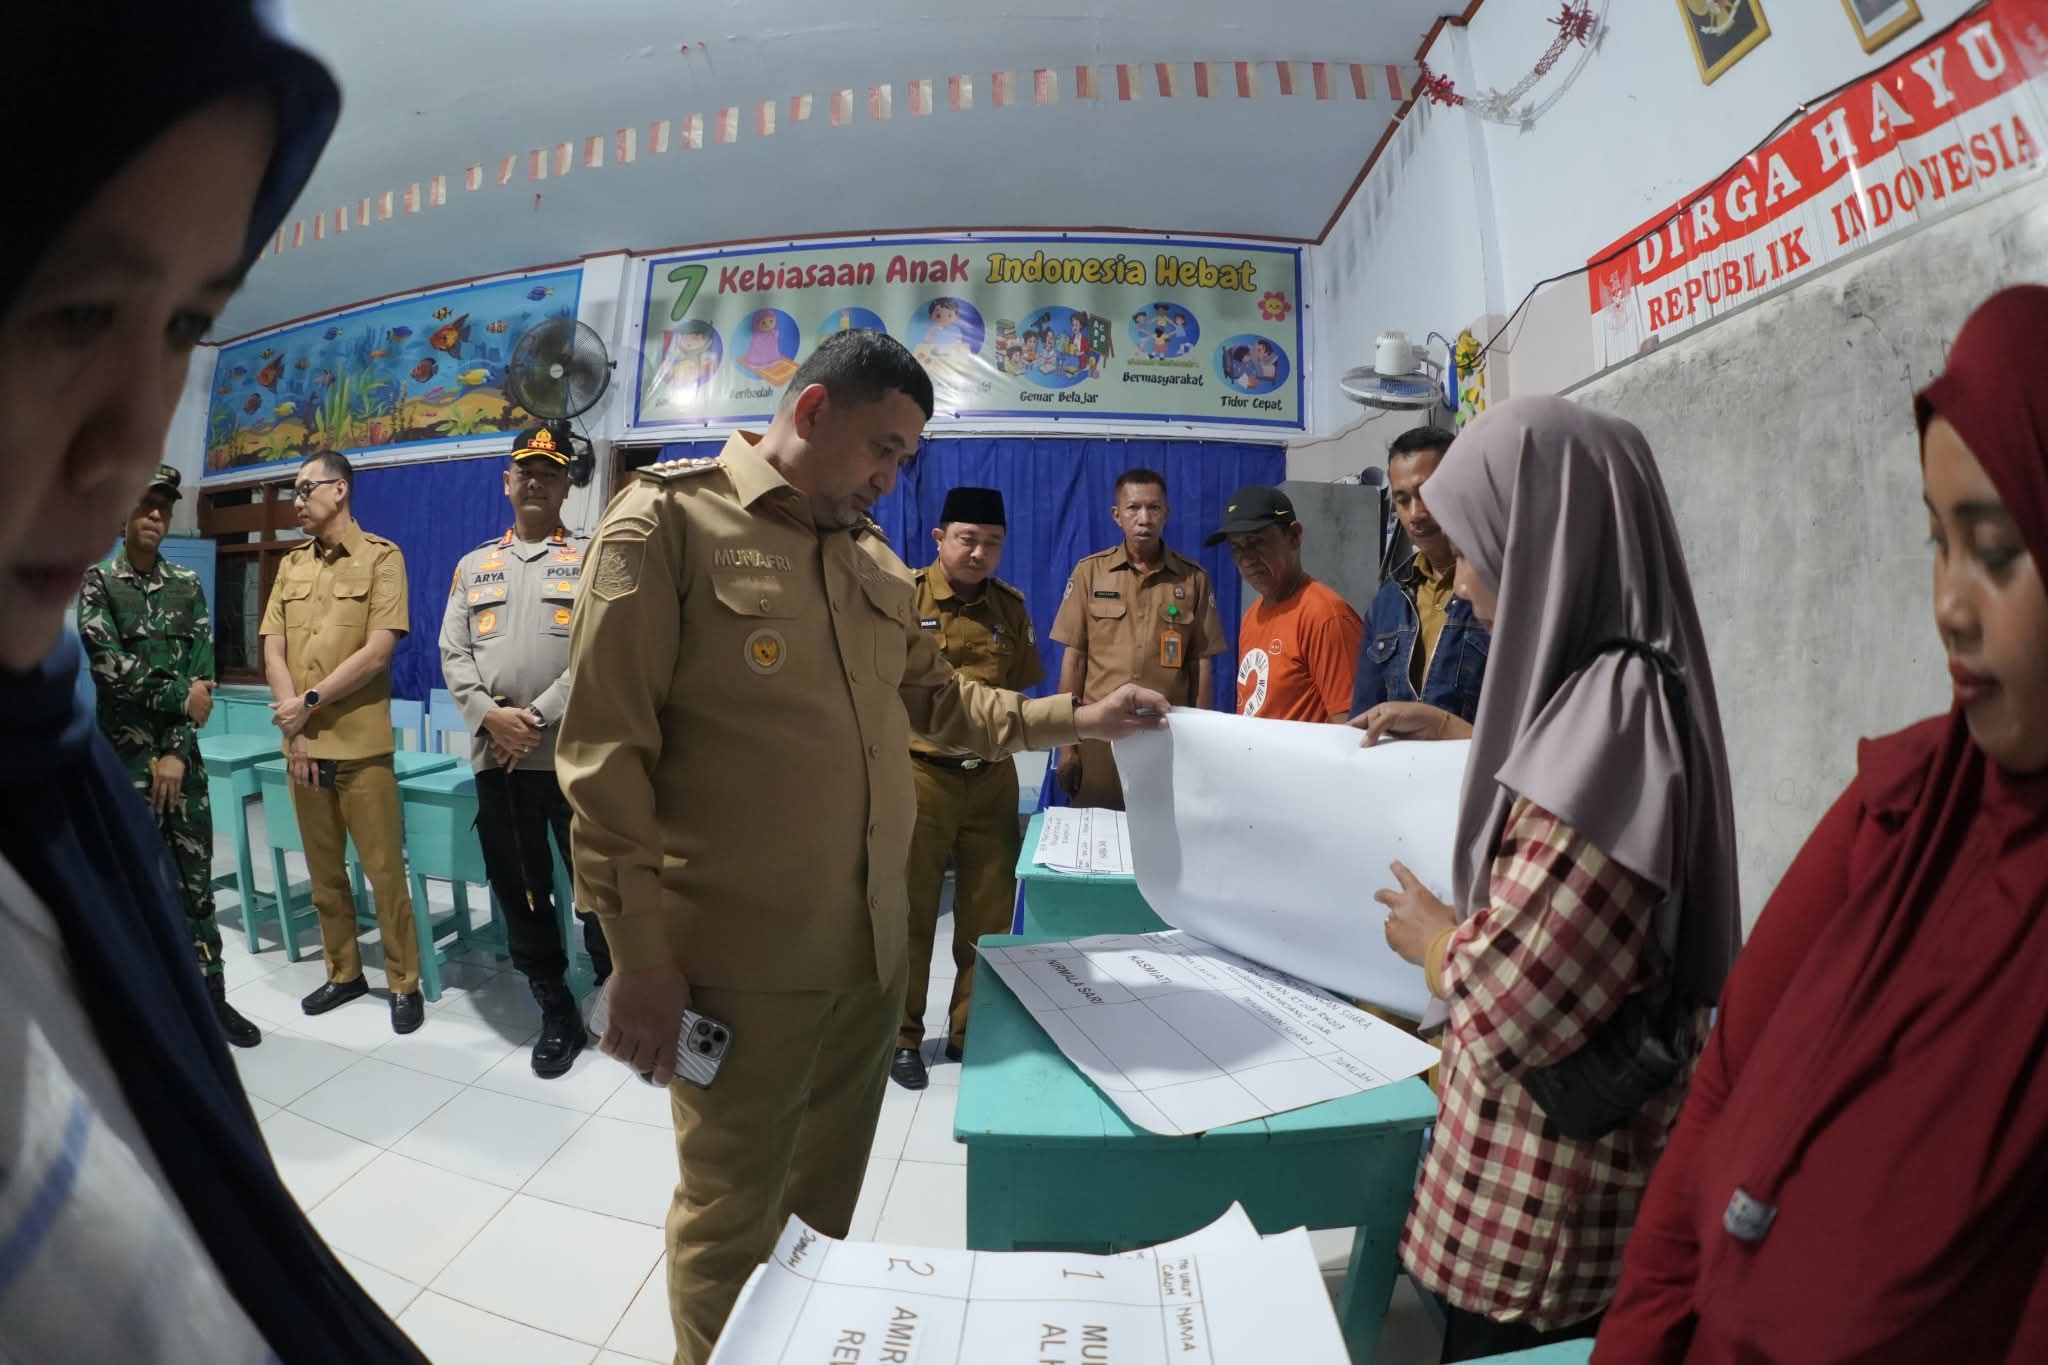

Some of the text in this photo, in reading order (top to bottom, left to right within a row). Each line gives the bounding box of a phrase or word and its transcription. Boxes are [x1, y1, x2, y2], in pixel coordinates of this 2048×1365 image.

[1647, 114, 2041, 332] REPUBLIK INDONESIA
[667, 251, 1257, 322] 7 Kebiasaan Anak Indonesia Hebat
[1122, 372, 1204, 387] Bermasyarakat
[1019, 391, 1099, 404] Gemar Belajar
[1220, 395, 1283, 412] Tidur Cepat
[713, 549, 792, 573] MUNAFRI
[474, 572, 505, 584] ARYA
[547, 567, 581, 577] POLR
[1078, 986, 1104, 1005] SARI
[888, 1257, 935, 1277] 2
[1061, 1268, 1105, 1279] 1
[829, 1329, 867, 1365] RE
[1039, 1323, 1067, 1352] AL
[1081, 1324, 1109, 1365] MU
